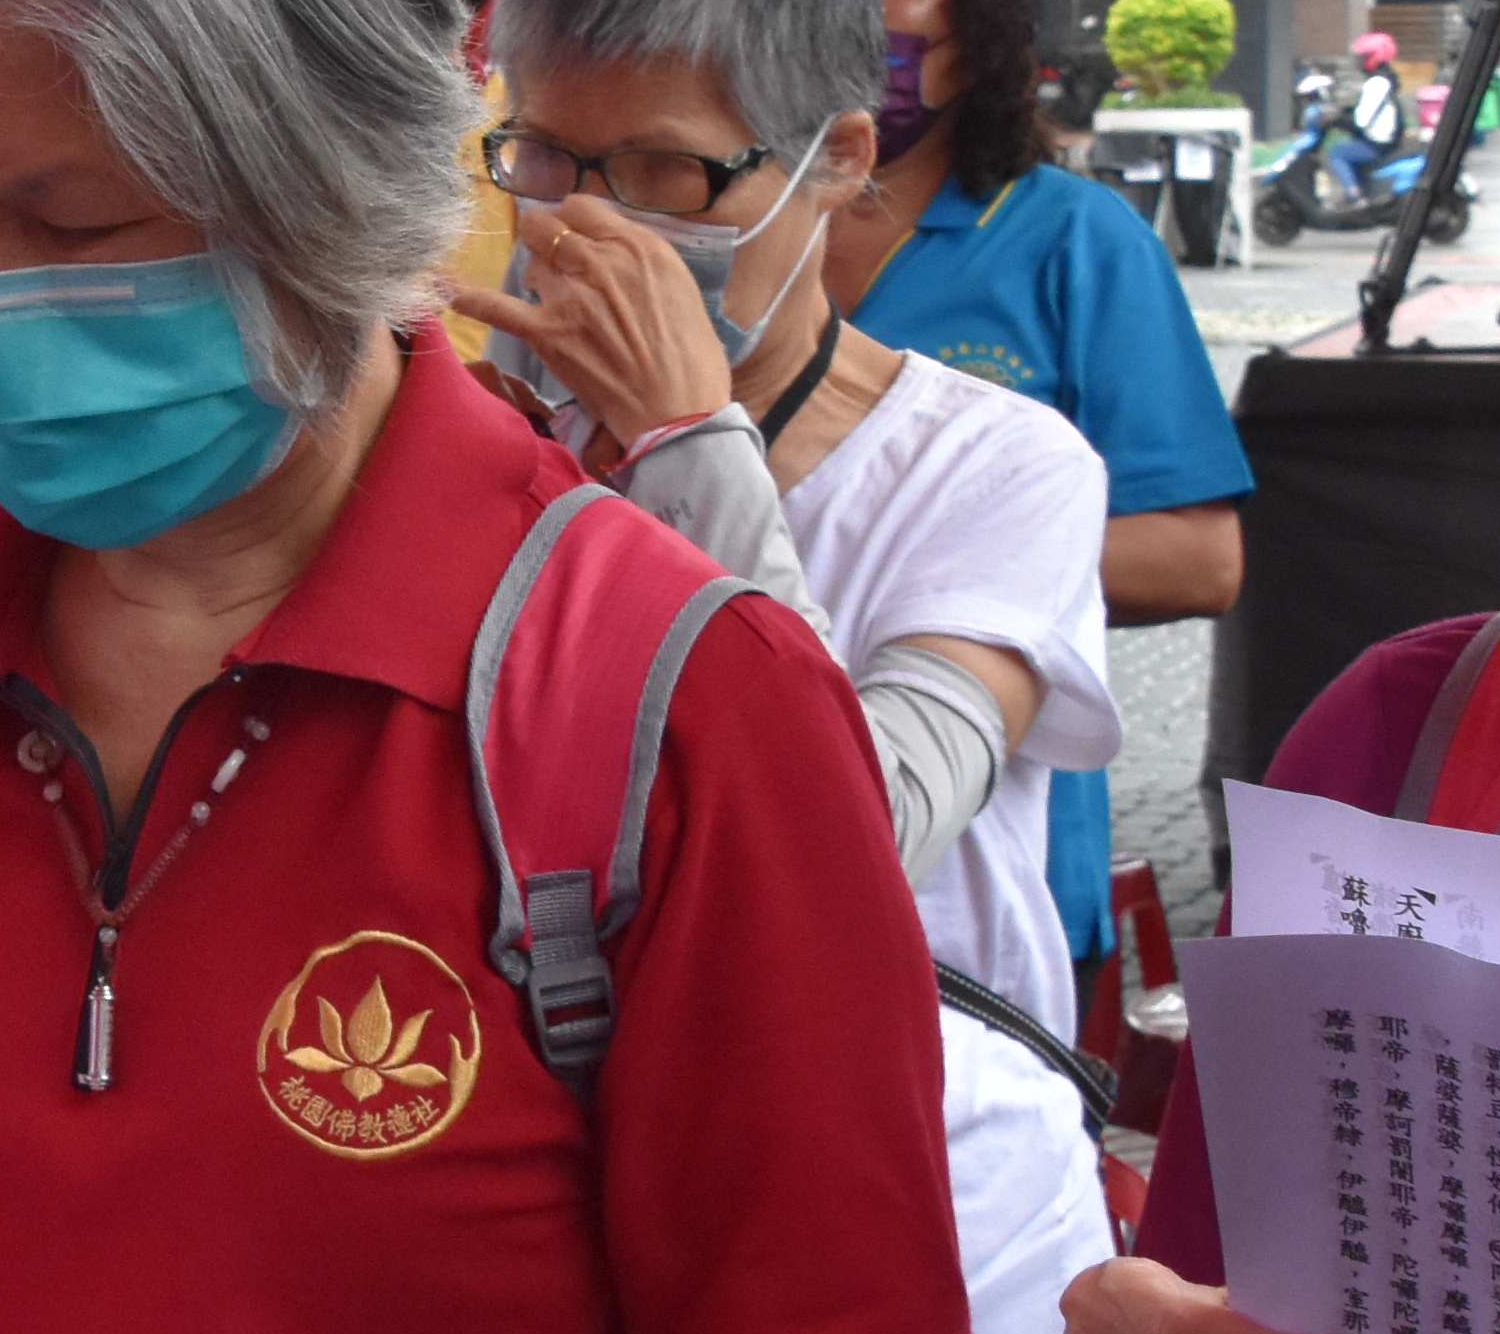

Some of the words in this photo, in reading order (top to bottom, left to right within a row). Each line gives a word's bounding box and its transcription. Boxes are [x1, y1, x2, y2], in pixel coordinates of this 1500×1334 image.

[277, 1074, 441, 1144] 桃園佛教蓮社
